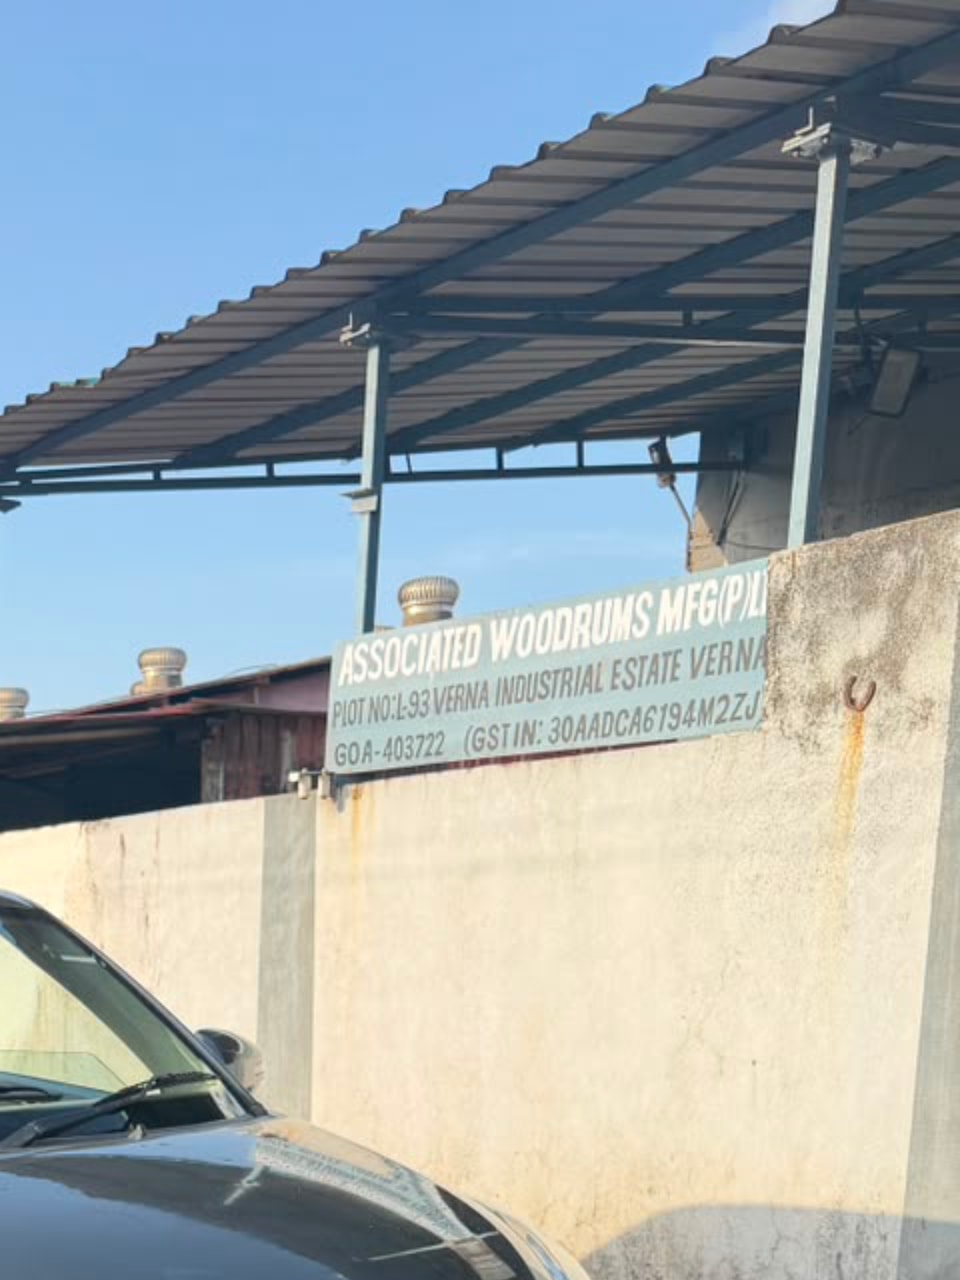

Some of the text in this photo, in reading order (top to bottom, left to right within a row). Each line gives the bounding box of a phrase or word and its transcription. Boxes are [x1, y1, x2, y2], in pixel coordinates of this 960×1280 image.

[332, 696, 365, 728] PLOT
[433, 679, 490, 716] VERNA
[495, 661, 604, 707] INDUSTRIAL
[610, 648, 683, 692] ESTATE
[690, 633, 768, 681] VERNA
[338, 623, 482, 687] ASSOCIATED
[489, 590, 653, 663] WOODRUMS
[334, 730, 445, 767] GOA-403722
